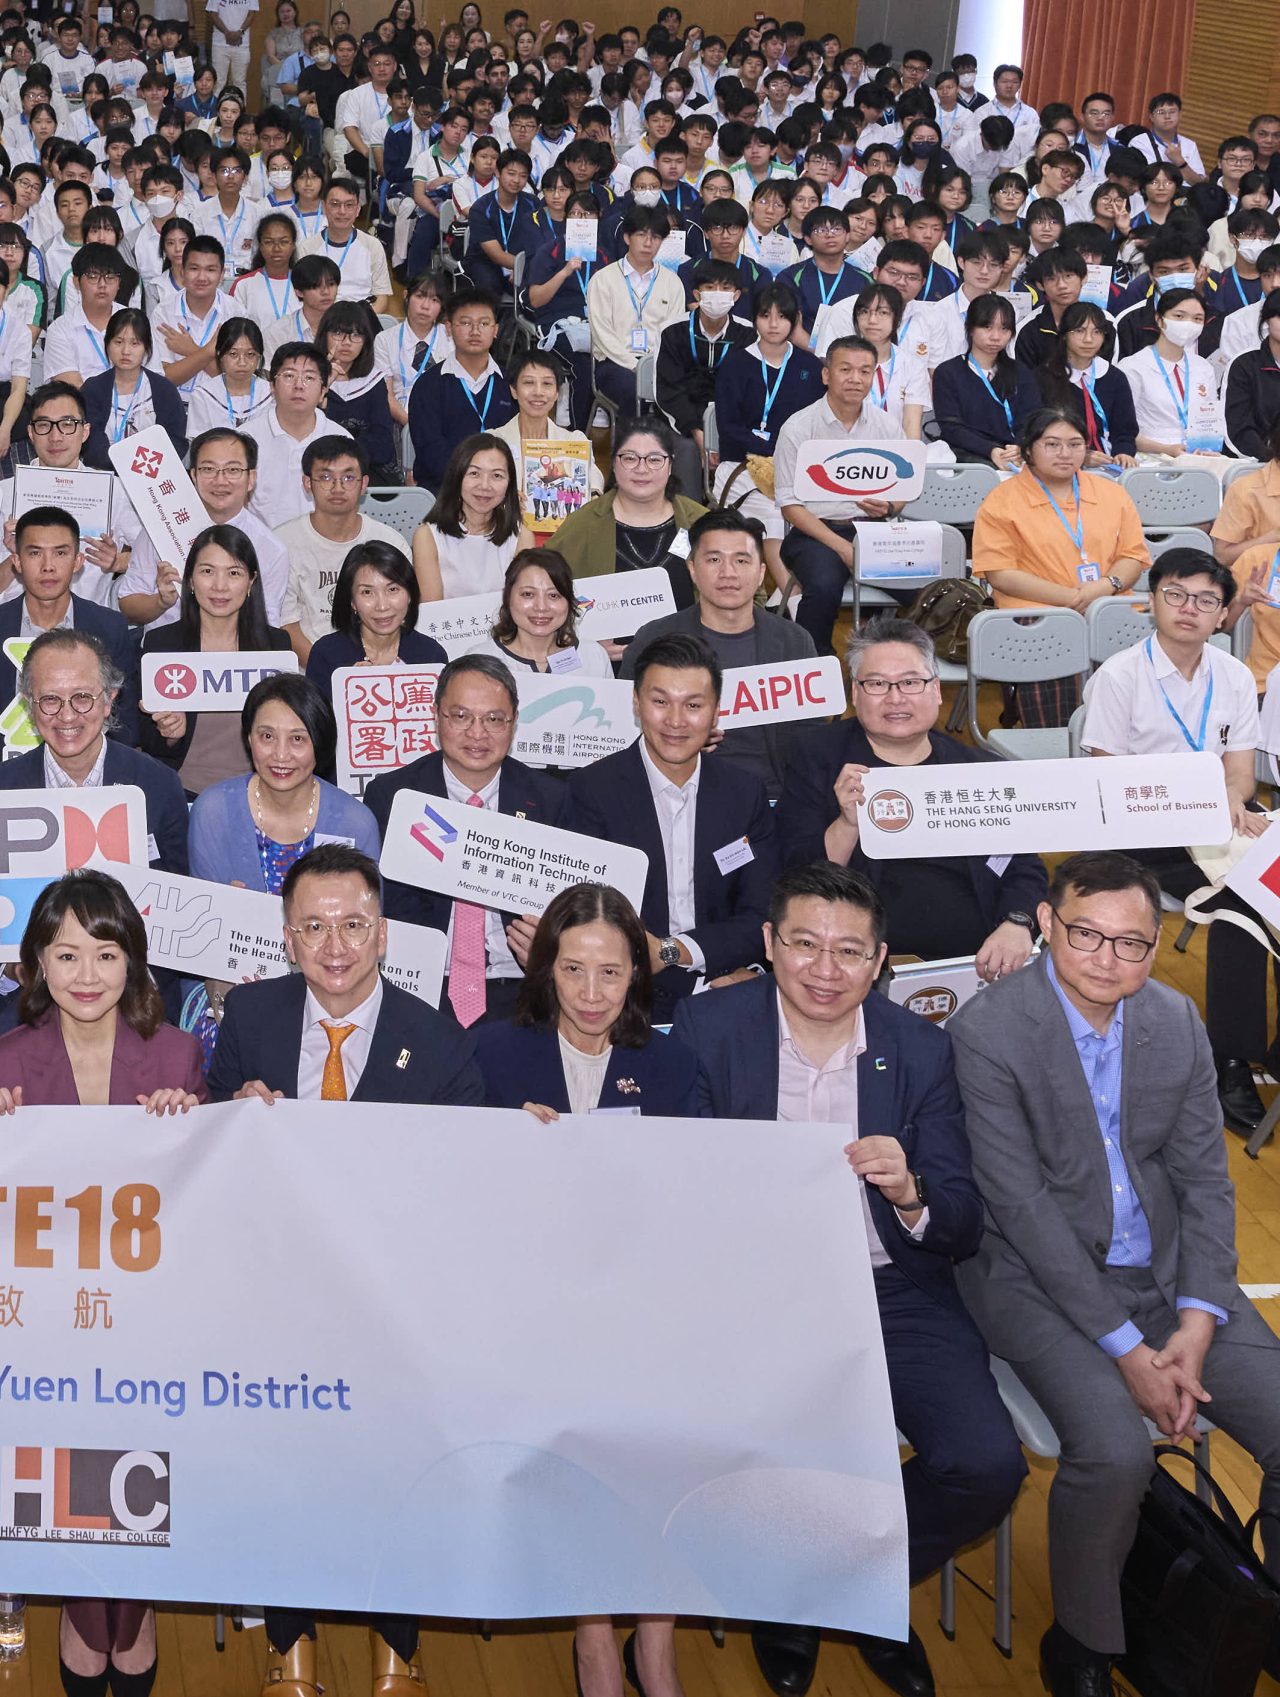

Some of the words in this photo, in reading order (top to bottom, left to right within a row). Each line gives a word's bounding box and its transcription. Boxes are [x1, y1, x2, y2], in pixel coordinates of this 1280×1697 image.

[835, 466, 889, 480] 5GNU
[147, 486, 158, 504] Hong
[157, 500, 167, 522] Kong
[164, 519, 186, 557] Association
[597, 600, 618, 612] CUHK
[620, 599, 630, 608] PI
[631, 594, 665, 607] CENTRE
[443, 629, 472, 642] Chinese
[542, 731, 566, 744] 香港
[573, 734, 599, 742] HONG
[601, 736, 626, 745] KONG
[517, 741, 565, 756] 國際機場
[573, 742, 625, 752] INTERNATIO
[573, 751, 606, 759] AIRPOR
[924, 787, 1017, 805] 香港恒生大學
[1124, 785, 1169, 801] 商學院
[926, 807, 947, 816] THE
[948, 805, 982, 816] HANG
[983, 804, 1012, 814] SENG
[1014, 801, 1078, 813] UNIVERSITY
[1126, 802, 1159, 813] School
[1161, 802, 1173, 812] of
[1175, 799, 1218, 811] Business
[927, 819, 941, 829] OF
[944, 818, 977, 828] HONG
[979, 816, 1012, 827] KONG
[463, 844, 534, 873] Information
[466, 829, 501, 850] Hong
[503, 839, 536, 860] Kong
[539, 848, 590, 872] Institute
[593, 864, 607, 876] of
[461, 859, 568, 893] 香港資訊科技
[457, 880, 489, 895] Member
[491, 889, 501, 898] of
[502, 892, 519, 903] VTC
[519, 897, 545, 911] Group
[229, 943, 248, 955] the
[251, 949, 287, 963] Heads
[230, 930, 251, 943] The
[255, 936, 287, 952] Hong
[406, 968, 422, 979] of
[94, 1367, 187, 1417] Long
[202, 1371, 352, 1412] District
[0, 1526, 40, 1540] HKFYG
[45, 1528, 64, 1541] LEE
[69, 1529, 97, 1542] SHAU
[103, 1531, 123, 1543] KEE
[127, 1532, 171, 1545] COLLEGE
